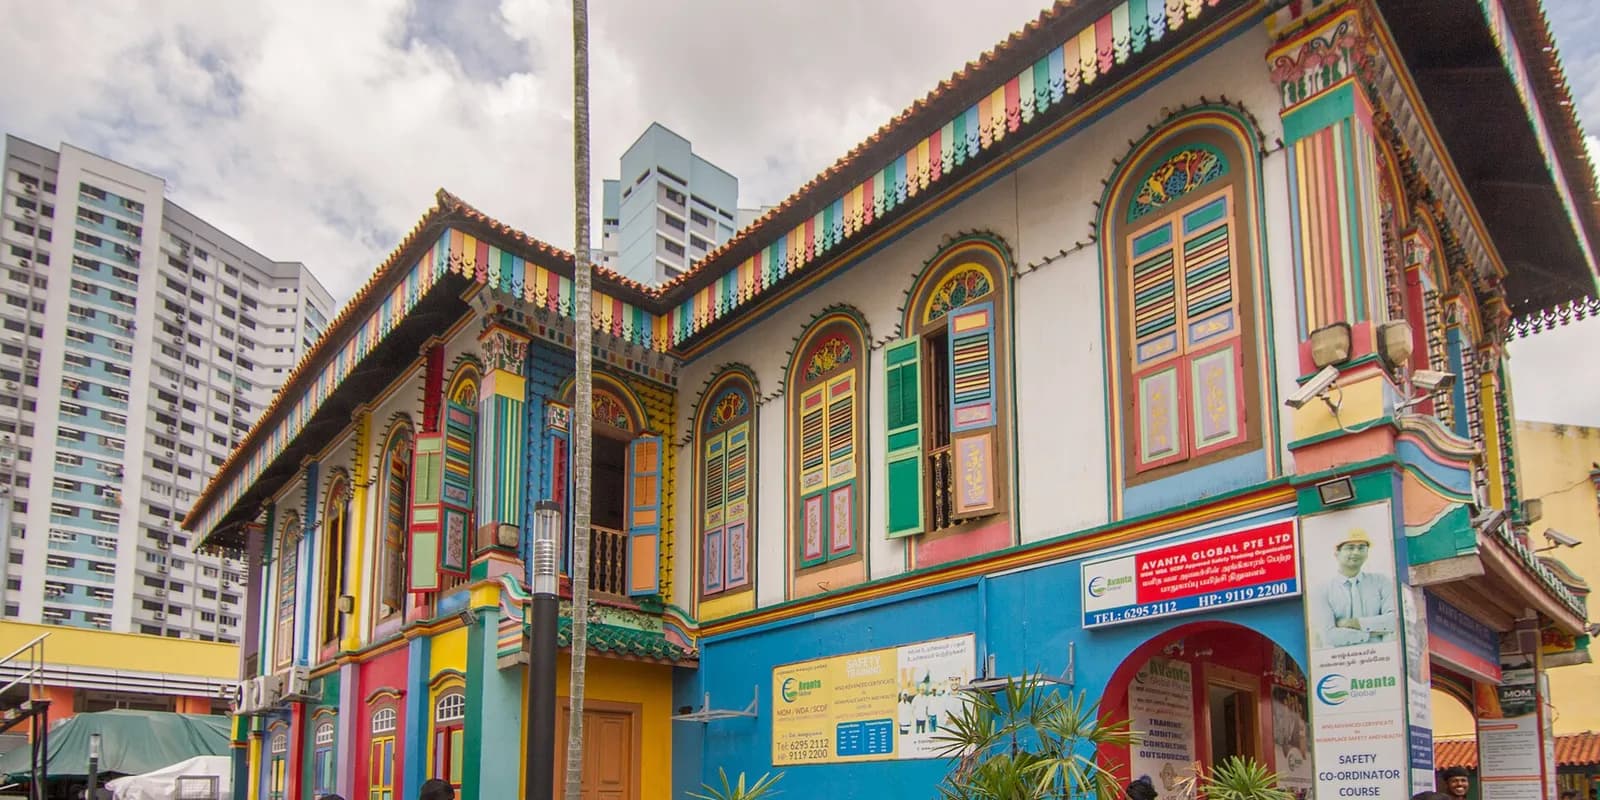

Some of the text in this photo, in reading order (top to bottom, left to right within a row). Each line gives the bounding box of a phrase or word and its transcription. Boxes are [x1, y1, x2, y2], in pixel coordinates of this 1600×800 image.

[1142, 534, 1290, 571] AVANTA GLOBAL PTE LTD
[1107, 575, 1133, 586] Avanta
[1094, 582, 1288, 625] TEL: 6295 2112 HP: 9119 2200
[1149, 660, 1190, 682] Avanta
[1350, 675, 1396, 690] Avanta
[1504, 690, 1533, 699] MOM
[790, 740, 808, 750] 6295
[810, 738, 829, 748] 2112
[789, 751, 807, 760] 9119
[809, 749, 828, 759] 2200
[1140, 750, 1190, 762] OUTSOURCING
[1339, 754, 1376, 765] SAFETY
[1319, 769, 1400, 781] CO-ORDINATOR
[1339, 786, 1380, 796] COURSE
